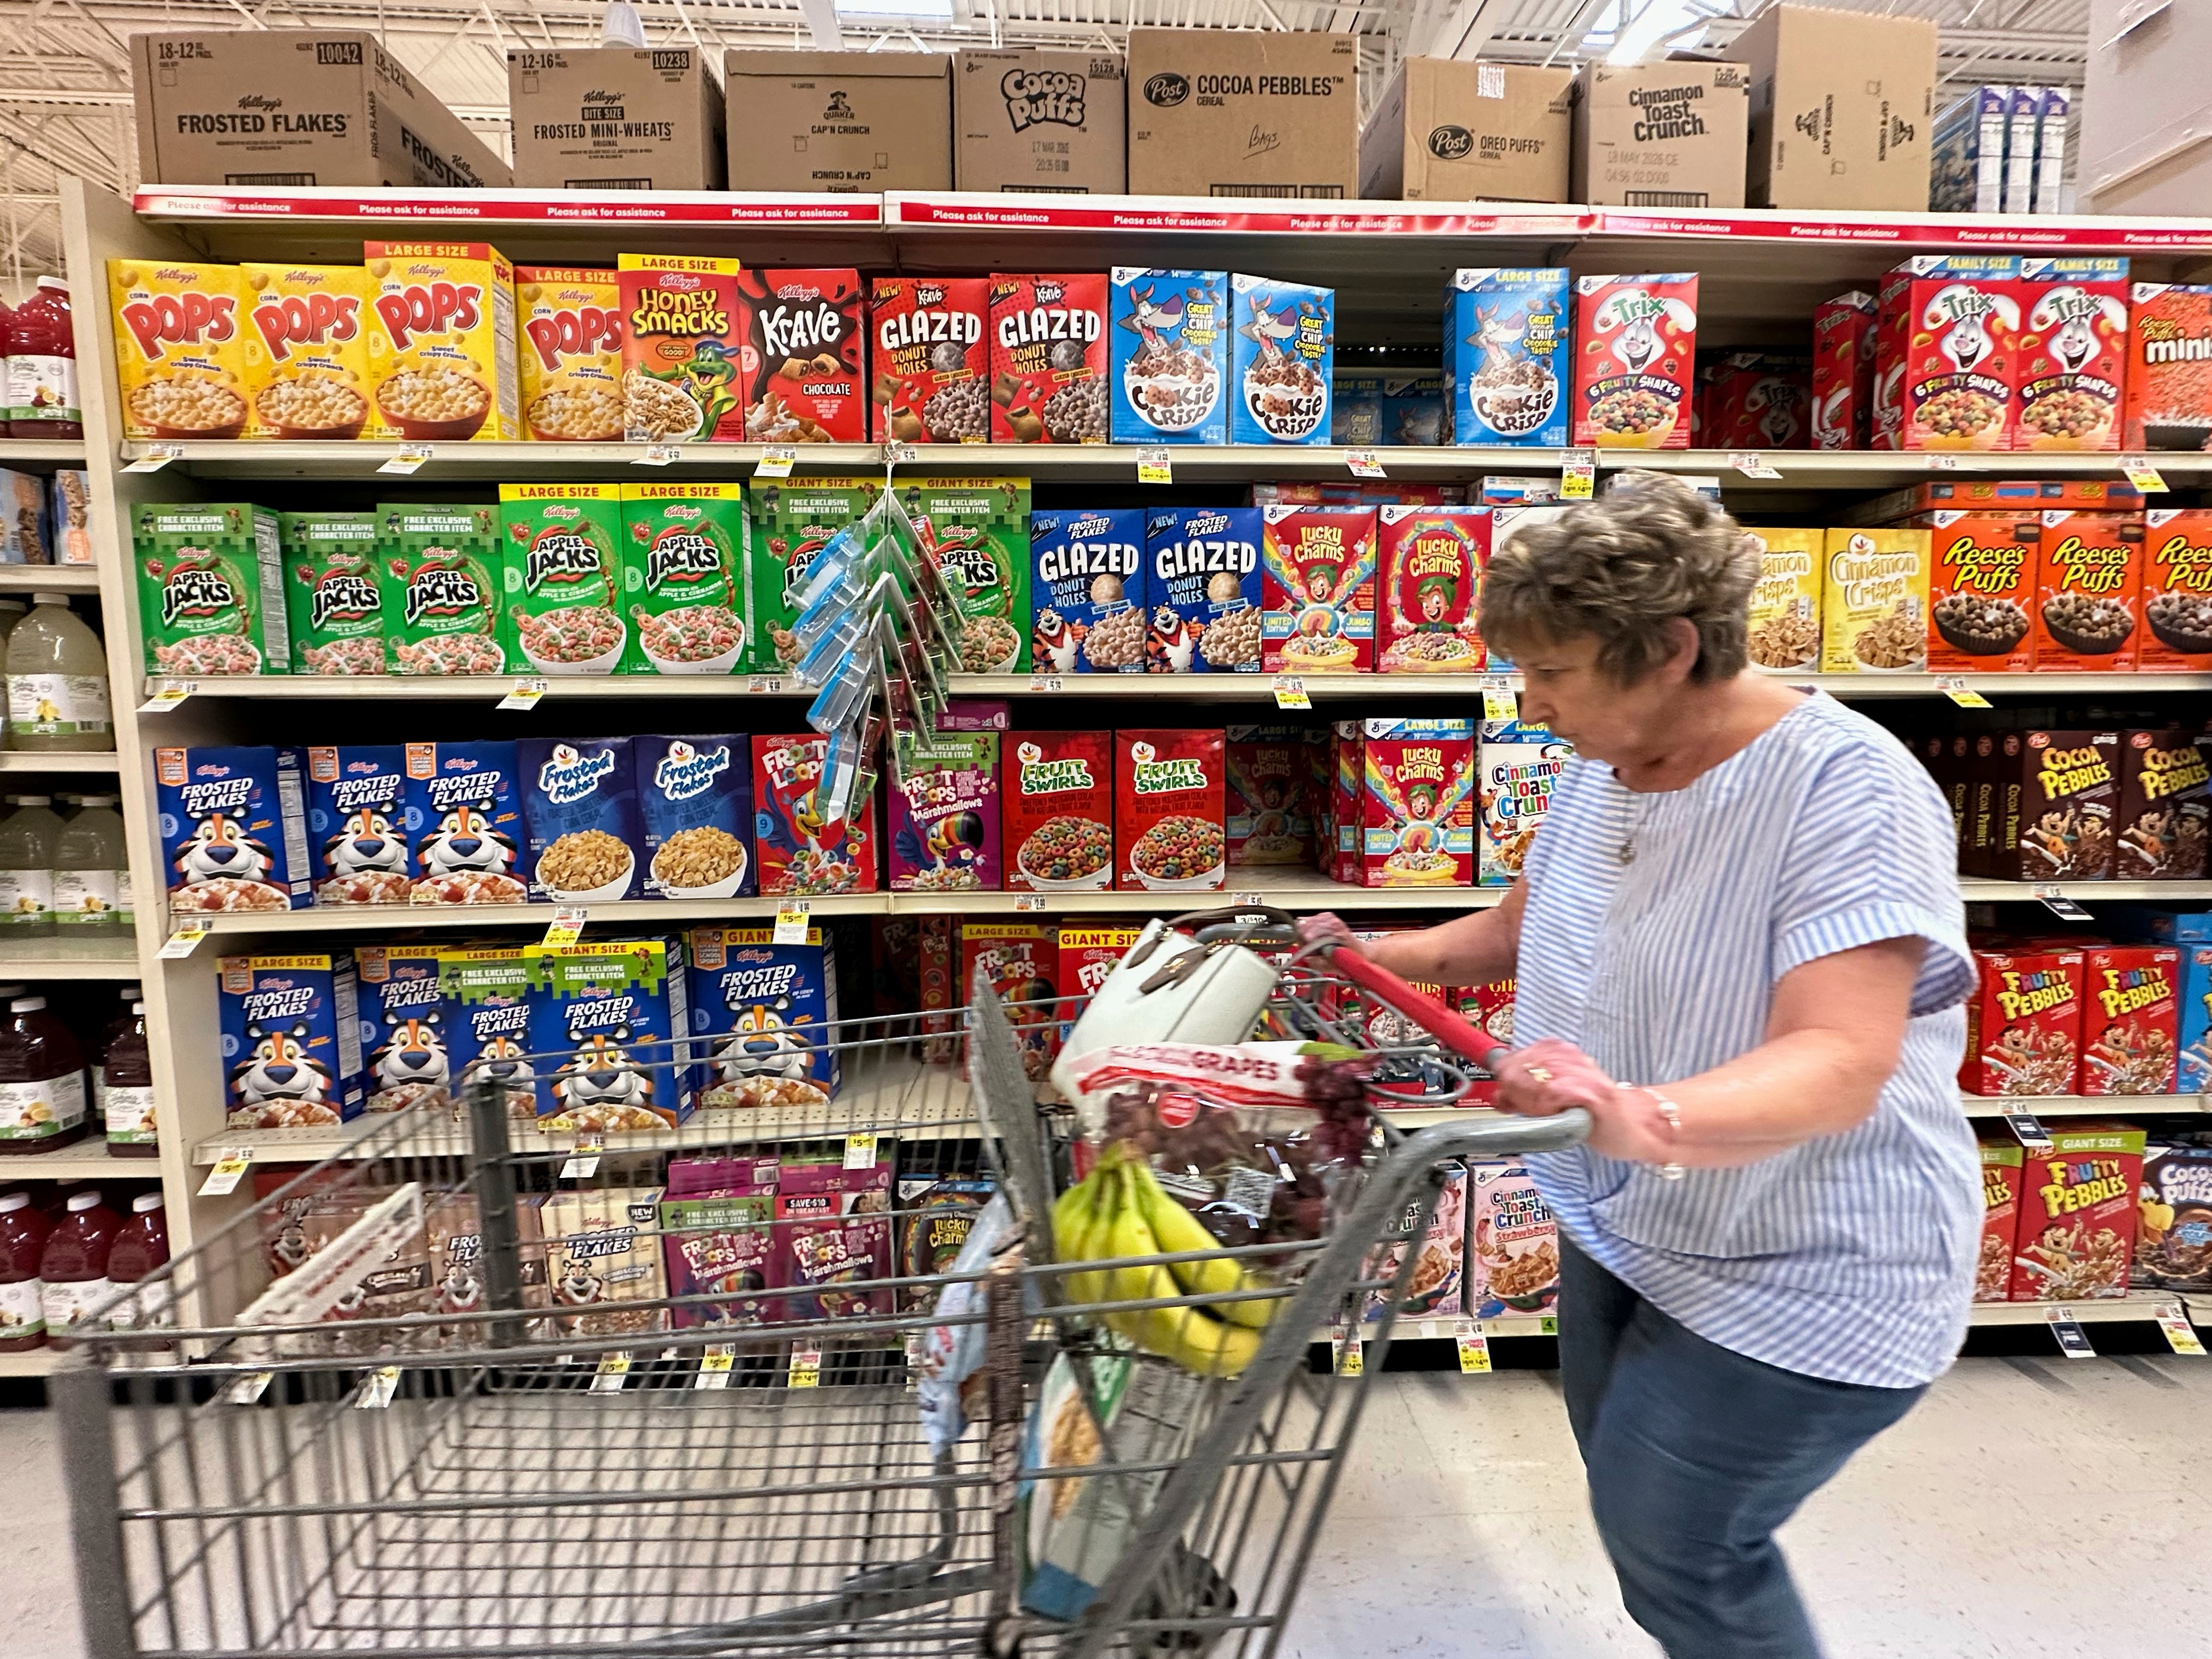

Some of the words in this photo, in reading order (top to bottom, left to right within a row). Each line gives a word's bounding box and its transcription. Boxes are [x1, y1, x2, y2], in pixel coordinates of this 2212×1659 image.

[159, 43, 193, 59] 18-12
[319, 43, 360, 63] 10042
[521, 54, 553, 69] 12-16
[654, 52, 688, 69] 10238
[1001, 69, 1086, 101] Cocoa
[1150, 79, 1184, 98] Post
[1197, 75, 1254, 95] COCOA
[238, 95, 282, 111] Kellogg's
[583, 90, 623, 104] Kellogg's
[1197, 97, 1224, 107] CEREAL
[1629, 86, 1704, 107] Cinnamon
[584, 108, 602, 119] BITE
[604, 107, 623, 119] SIZE
[824, 111, 854, 120] QUAKER
[1006, 94, 1086, 133] Puffs
[1642, 103, 1691, 122] Toast
[178, 113, 265, 133] FROSTED
[273, 113, 346, 133] FLAKES
[534, 123, 585, 139] FROSTED
[591, 121, 672, 137] MINI-WHEATS
[811, 125, 835, 134] CAP'N
[838, 125, 870, 134] CRUNCH
[1634, 115, 1705, 142] Crunch
[1435, 132, 1468, 150] Post
[1481, 135, 1506, 150] OREO
[1509, 139, 1540, 153] PUFFS
[1480, 150, 1502, 159] CEREAL
[359, 204, 392, 213] Please
[393, 205, 411, 214] ask
[413, 205, 427, 214] for
[429, 205, 480, 214] assistance
[732, 208, 763, 217] Please
[766, 209, 782, 217] ask
[784, 209, 798, 217] for
[799, 209, 849, 217] assistance
[1113, 215, 1144, 225] Please
[1146, 216, 1163, 225] ask
[1164, 216, 1178, 225] for
[1179, 217, 1227, 226] assistance
[385, 244, 431, 257] LARGE
[436, 245, 469, 257] SIZE
[642, 258, 684, 269] LARGE
[689, 260, 717, 270] SIZE
[1947, 257, 1985, 270] FAMILY
[1988, 257, 2011, 270] SIZE
[155, 269, 198, 283] Kellogg's
[659, 274, 700, 288] Kellogg's
[1495, 270, 1532, 282] LARGE
[1535, 270, 1560, 281] SIZE
[777, 286, 819, 300] Kellogg's
[878, 283, 901, 299] NEW!
[1187, 303, 1214, 315] GREAT
[1612, 289, 1668, 326] Trix
[1942, 287, 1995, 320] Trix
[375, 281, 481, 352] POPS
[1189, 318, 1215, 331] CHIP
[121, 292, 236, 361] POPS
[881, 310, 982, 351] GLAZED
[1189, 334, 1212, 346] TASTE!
[891, 345, 927, 366] DONUT
[171, 361, 196, 370] Crispy
[197, 362, 222, 371] Crunch
[895, 359, 928, 377] HOLES
[803, 383, 851, 396] CHOCOLATE
[1589, 385, 1599, 398] 6
[1639, 376, 1682, 398] SHAPES
[520, 486, 561, 497] LARGE
[565, 486, 599, 497] SIZE
[786, 479, 820, 488] GIANT
[822, 478, 852, 488] SIZE
[404, 515, 424, 525] FREE
[426, 515, 473, 525] EXCLUSIVE
[543, 505, 580, 518] Kellogg's
[404, 523, 449, 533] CHARACTER
[451, 524, 473, 533] ITEM
[1038, 516, 1061, 531] NEW!
[1067, 517, 1110, 533] FROSTED
[1070, 526, 1107, 540] FLAKES
[1300, 526, 1343, 547] Lucky
[537, 535, 584, 552] APPLE
[1294, 542, 1345, 563] Charms
[1944, 536, 2026, 566] Reese's
[526, 546, 601, 593] JACKS
[1039, 542, 1139, 582] GLAZED
[1835, 554, 1917, 581] Cinnamon
[1050, 578, 1086, 597] DONUT
[1953, 563, 2022, 594] Puffs
[1055, 591, 1087, 608] HOLES
[1849, 578, 1904, 607] Crisps
[1263, 617, 1292, 626] LIMITED
[1266, 624, 1289, 633] EDITION
[1346, 618, 1372, 627] JUMBO
[1404, 719, 1439, 731] LARGE
[1442, 719, 1465, 730] SIZE
[1402, 747, 1442, 766] Lucky
[2041, 745, 2102, 770] COCOA
[197, 764, 230, 776] Kellogg's
[543, 754, 611, 787] Frosted
[1022, 760, 1085, 781] FRUIT
[1395, 762, 1445, 782] Charms
[181, 777, 254, 800] FROSTED
[555, 777, 595, 800] Flakes
[903, 770, 953, 796] FROOT
[1023, 774, 1092, 794] SWIRLS
[1510, 778, 1557, 798] Toast
[2037, 762, 2111, 801] PEBBLES
[186, 792, 248, 812] FLAKES
[910, 787, 956, 809] LOOPS
[911, 798, 983, 822] Marshmallows
[1061, 934, 1110, 946] GIANT
[561, 945, 598, 955] GIANT
[601, 944, 627, 954] SIZE
[254, 957, 292, 968] LARGE
[296, 957, 324, 967] SIZE
[242, 987, 314, 1010] FROSTED
[565, 996, 633, 1019] FROSTED
[1996, 981, 2075, 1022] PEBBLES
[247, 1002, 308, 1021] FLAKES
[569, 1010, 629, 1030] FLAKES
[2063, 1138, 2097, 1149] GIANT
[2099, 1138, 2123, 1148] SIZE
[790, 1199, 810, 1208] SAVE
[811, 1197, 827, 1208] $10
[1504, 1197, 1541, 1213] Toast
[2039, 1173, 2127, 1219] PEBBLES
[1496, 1206, 1551, 1228] Crunch
[1496, 1224, 1555, 1242] Strawberry
[802, 1254, 873, 1279] Marshmallows
